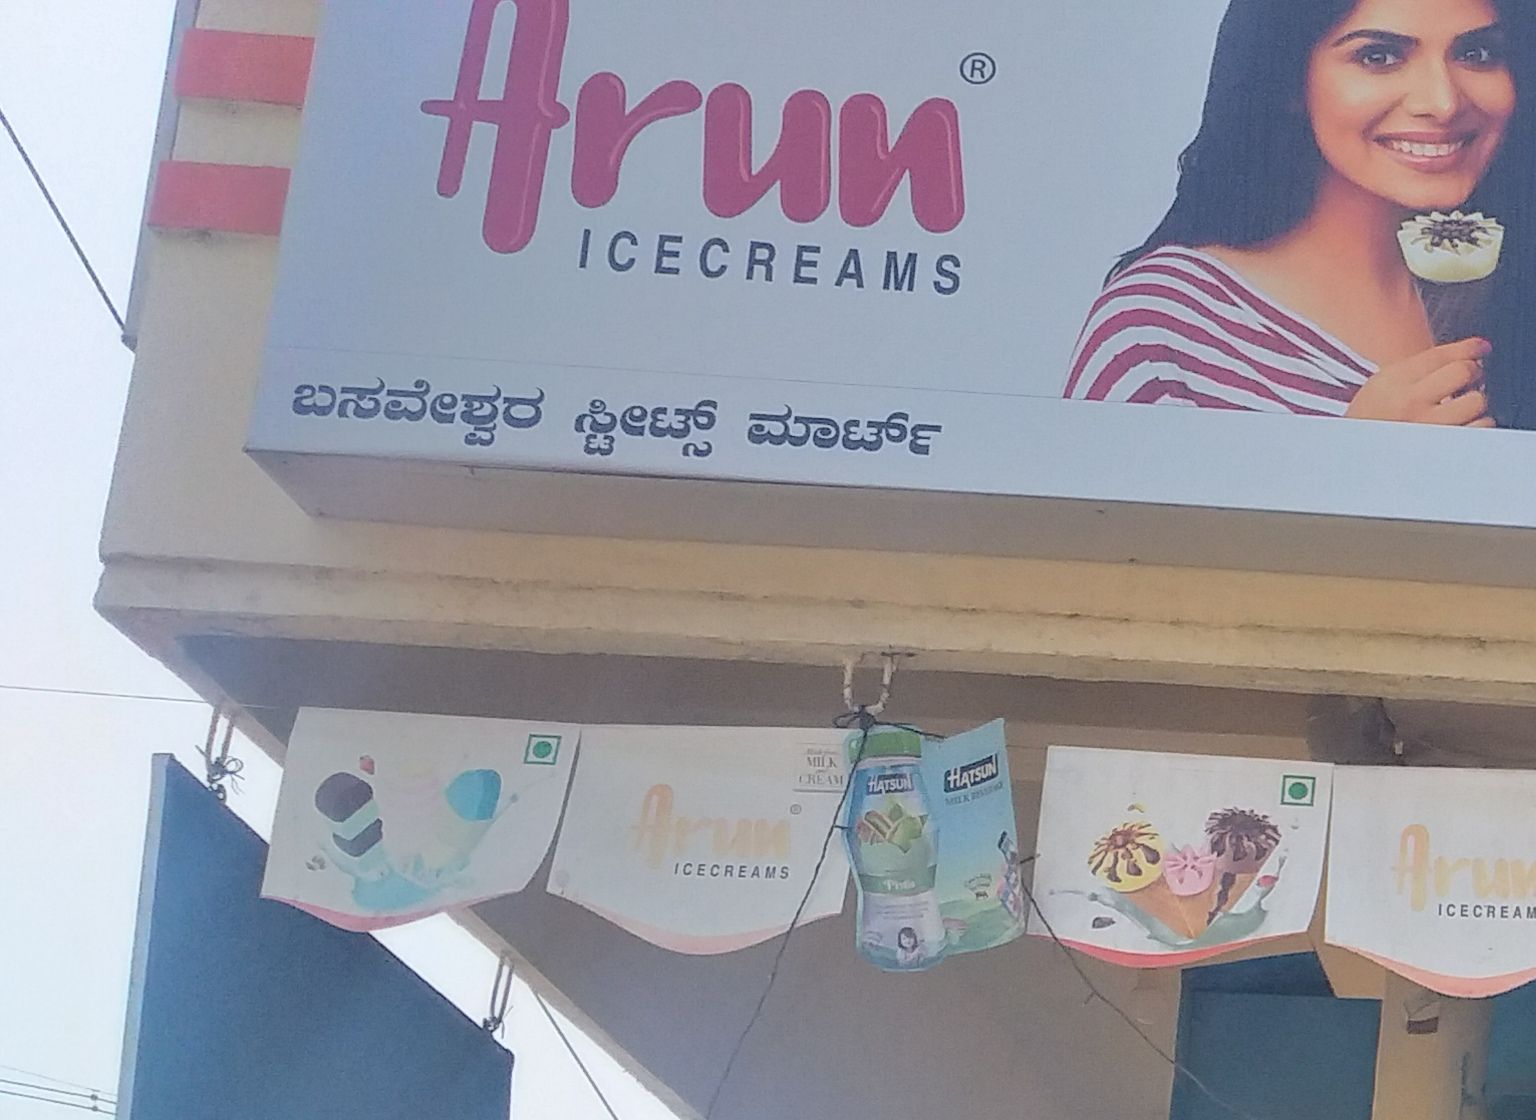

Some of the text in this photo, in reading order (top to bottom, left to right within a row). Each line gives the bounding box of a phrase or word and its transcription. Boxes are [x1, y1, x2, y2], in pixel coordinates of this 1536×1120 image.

[420, 0, 966, 254] Arun
[578, 228, 964, 296] ICECREAMS
[293, 377, 544, 446] ಬಸವೇಶ್ವರ
[747, 405, 943, 456] ಮಾರ್ಟ್
[867, 773, 913, 795] HATSUN
[945, 755, 998, 790] HATSUN
[631, 783, 792, 870] Arun
[673, 862, 791, 880] ICECREAMS
